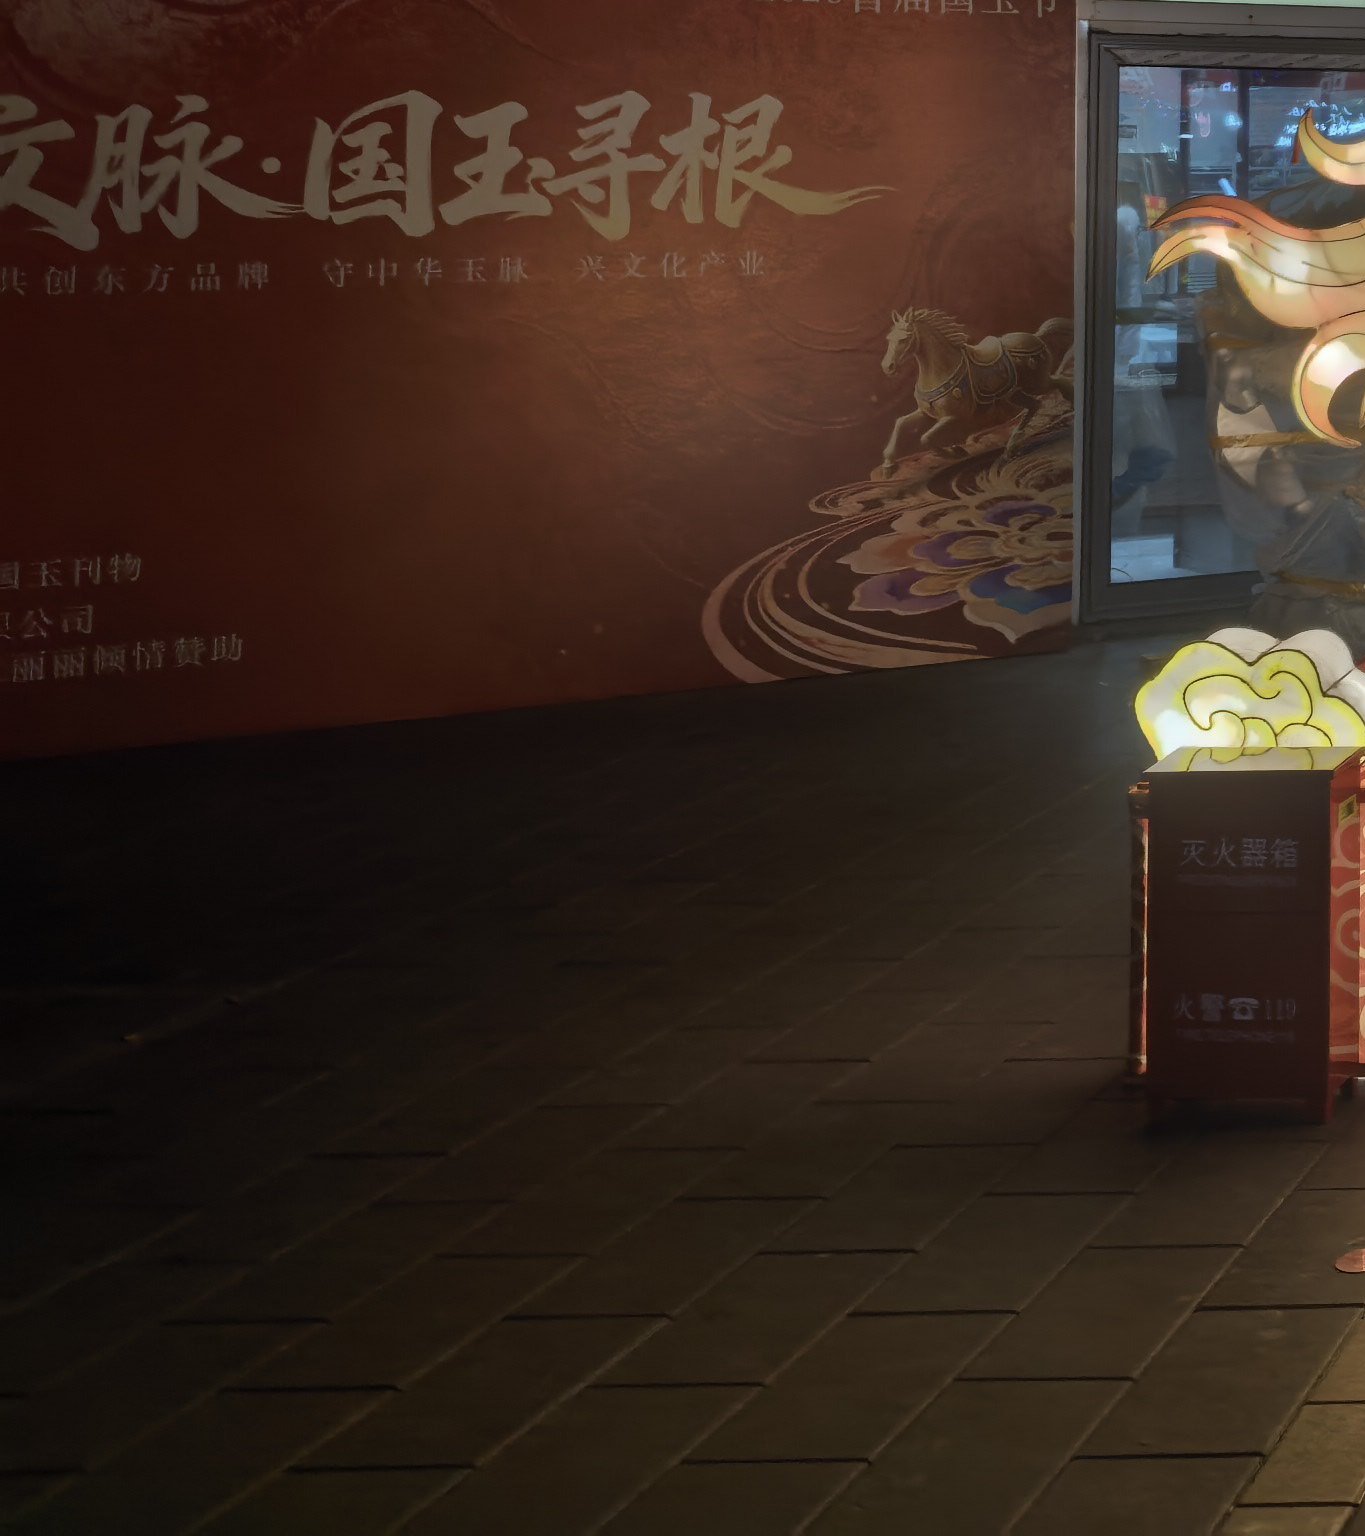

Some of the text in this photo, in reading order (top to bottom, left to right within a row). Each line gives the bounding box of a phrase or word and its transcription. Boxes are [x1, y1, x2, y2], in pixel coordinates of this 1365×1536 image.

[578, 251, 766, 282] 兴文化产业
[1180, 837, 1299, 868] 灭火器箱
